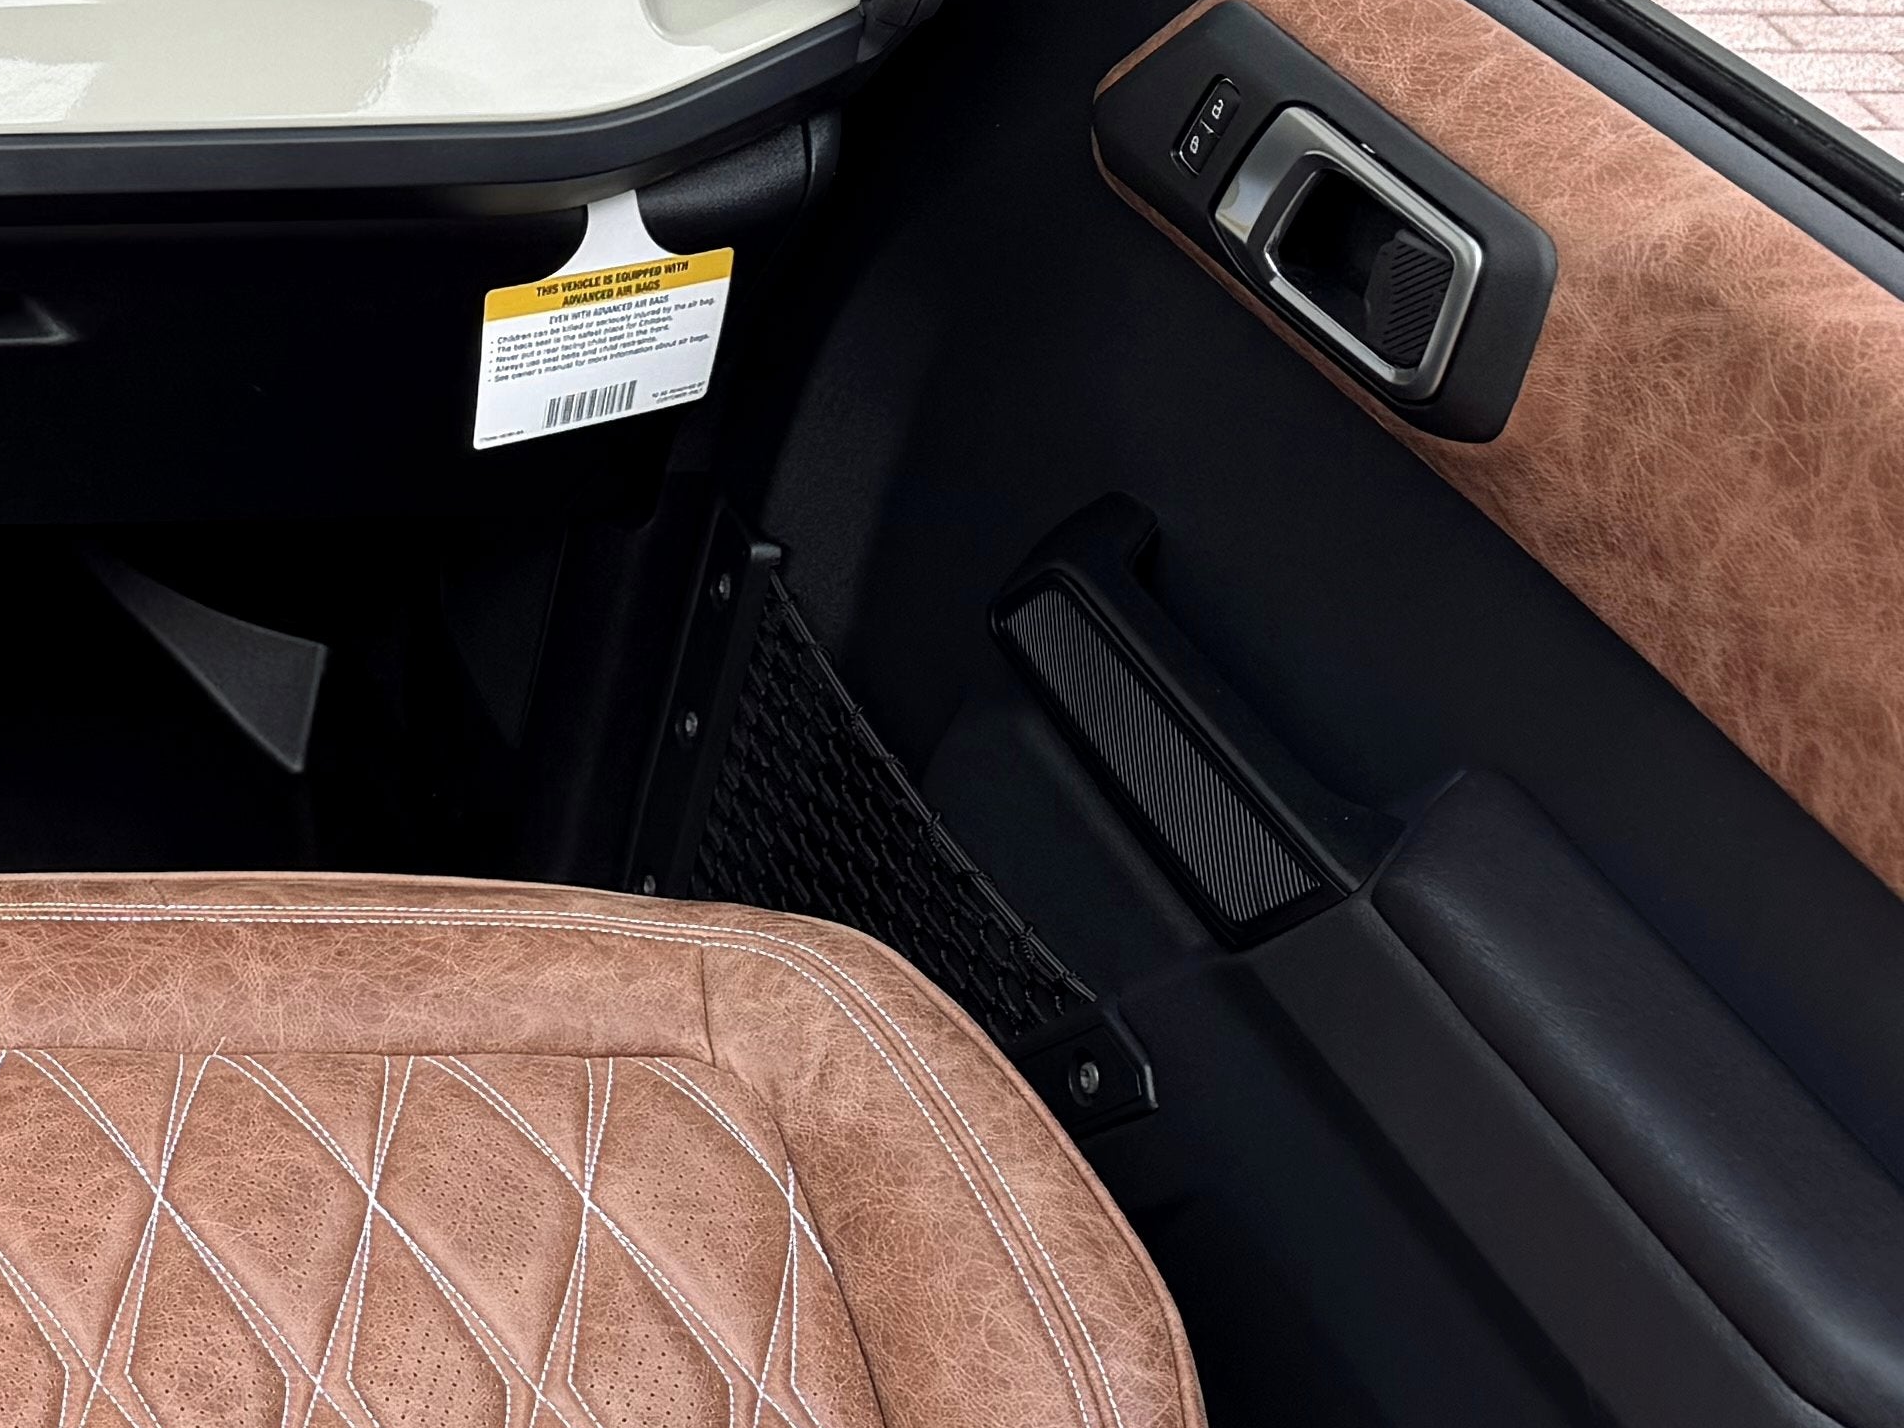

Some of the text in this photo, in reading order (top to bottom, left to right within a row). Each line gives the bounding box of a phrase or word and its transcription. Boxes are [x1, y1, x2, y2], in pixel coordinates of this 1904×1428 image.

[536, 260, 689, 297] THIS VEHICLE IS EQUIPPED WITH
[562, 280, 661, 307] ADVANCED AIR BAGS
